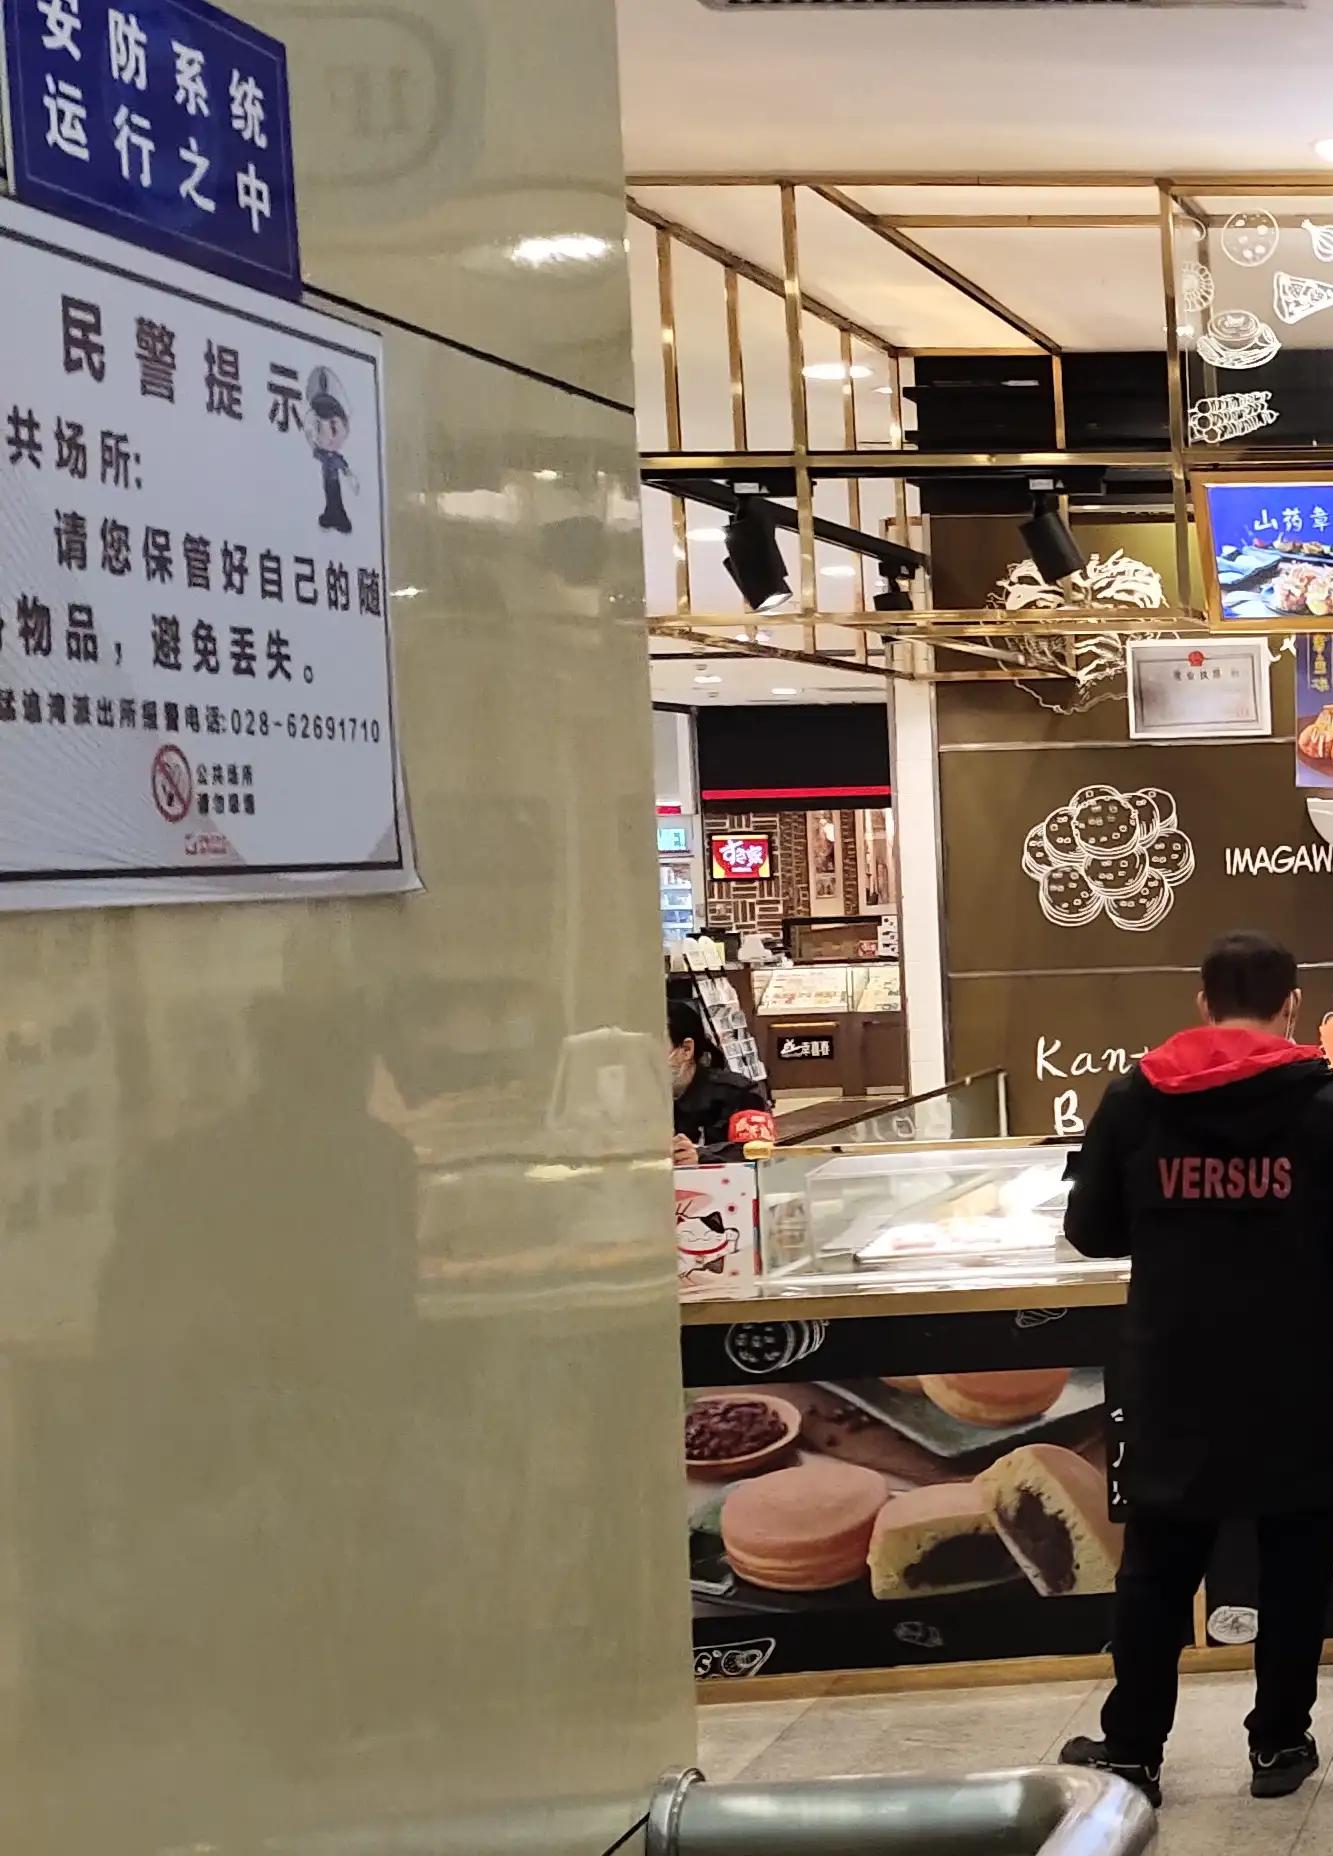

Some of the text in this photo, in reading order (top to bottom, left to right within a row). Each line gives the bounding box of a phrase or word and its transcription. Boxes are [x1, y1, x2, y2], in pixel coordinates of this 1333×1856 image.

[37, 0, 268, 149] 安防系统
[42, 74, 272, 234] 运行之中
[61, 294, 304, 434] 民警提示
[54, 508, 383, 617] 请您保管好自己的随
[0, 592, 314, 684] 物品，避免丢失。
[1158, 1156, 1292, 1199] VERSUS
